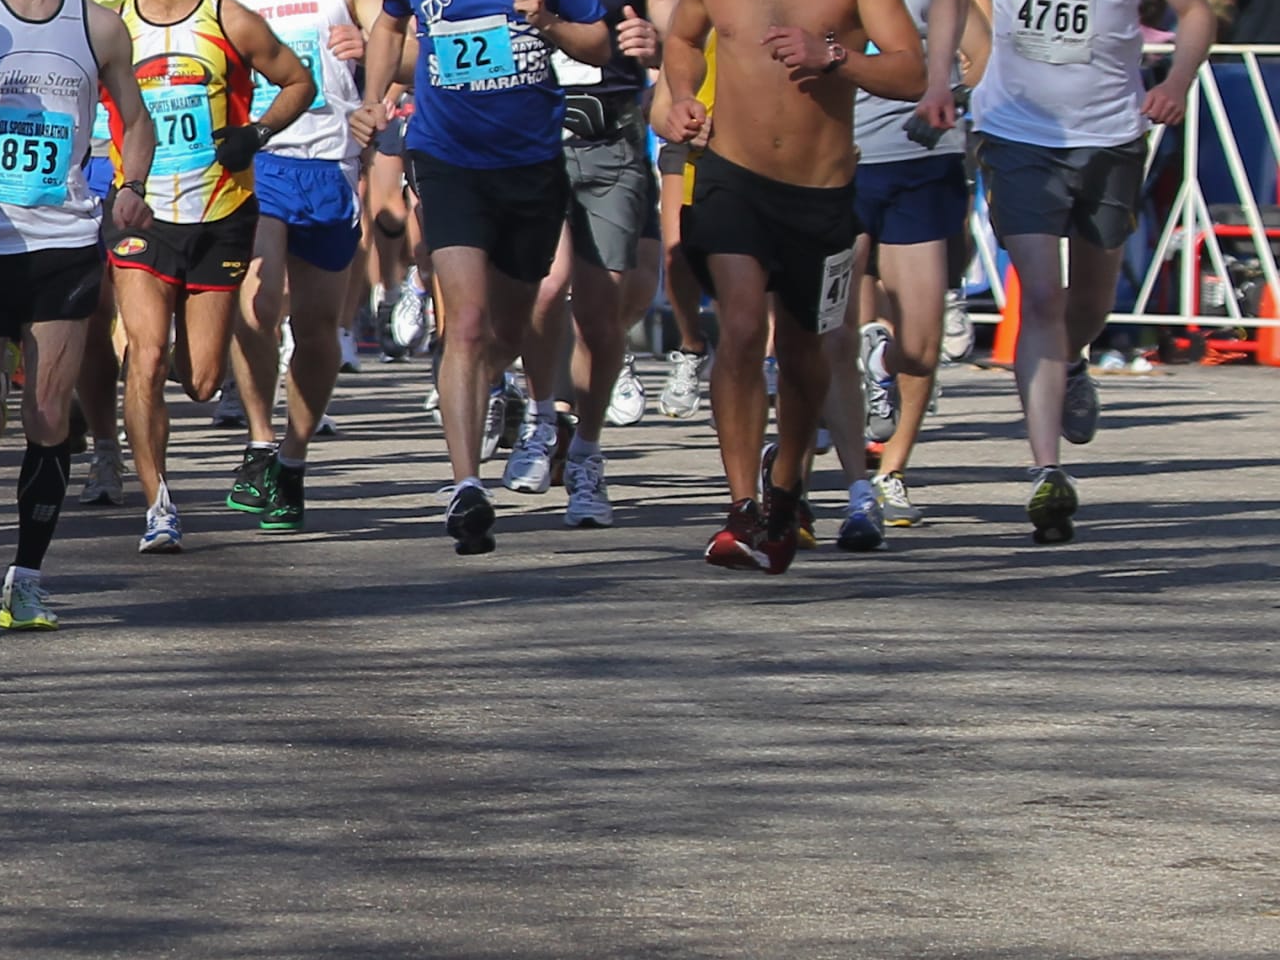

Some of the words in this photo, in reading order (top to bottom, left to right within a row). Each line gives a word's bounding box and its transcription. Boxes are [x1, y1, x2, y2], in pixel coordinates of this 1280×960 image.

[277, 2, 318, 17] GUARD
[453, 36, 491, 69] 22
[45, 72, 83, 88] Street
[470, 71, 548, 91] MARATHON
[170, 96, 202, 111] MARATHON
[9, 119, 34, 136] SPORTS
[36, 122, 69, 139] MARATHON
[1, 138, 58, 175] 853
